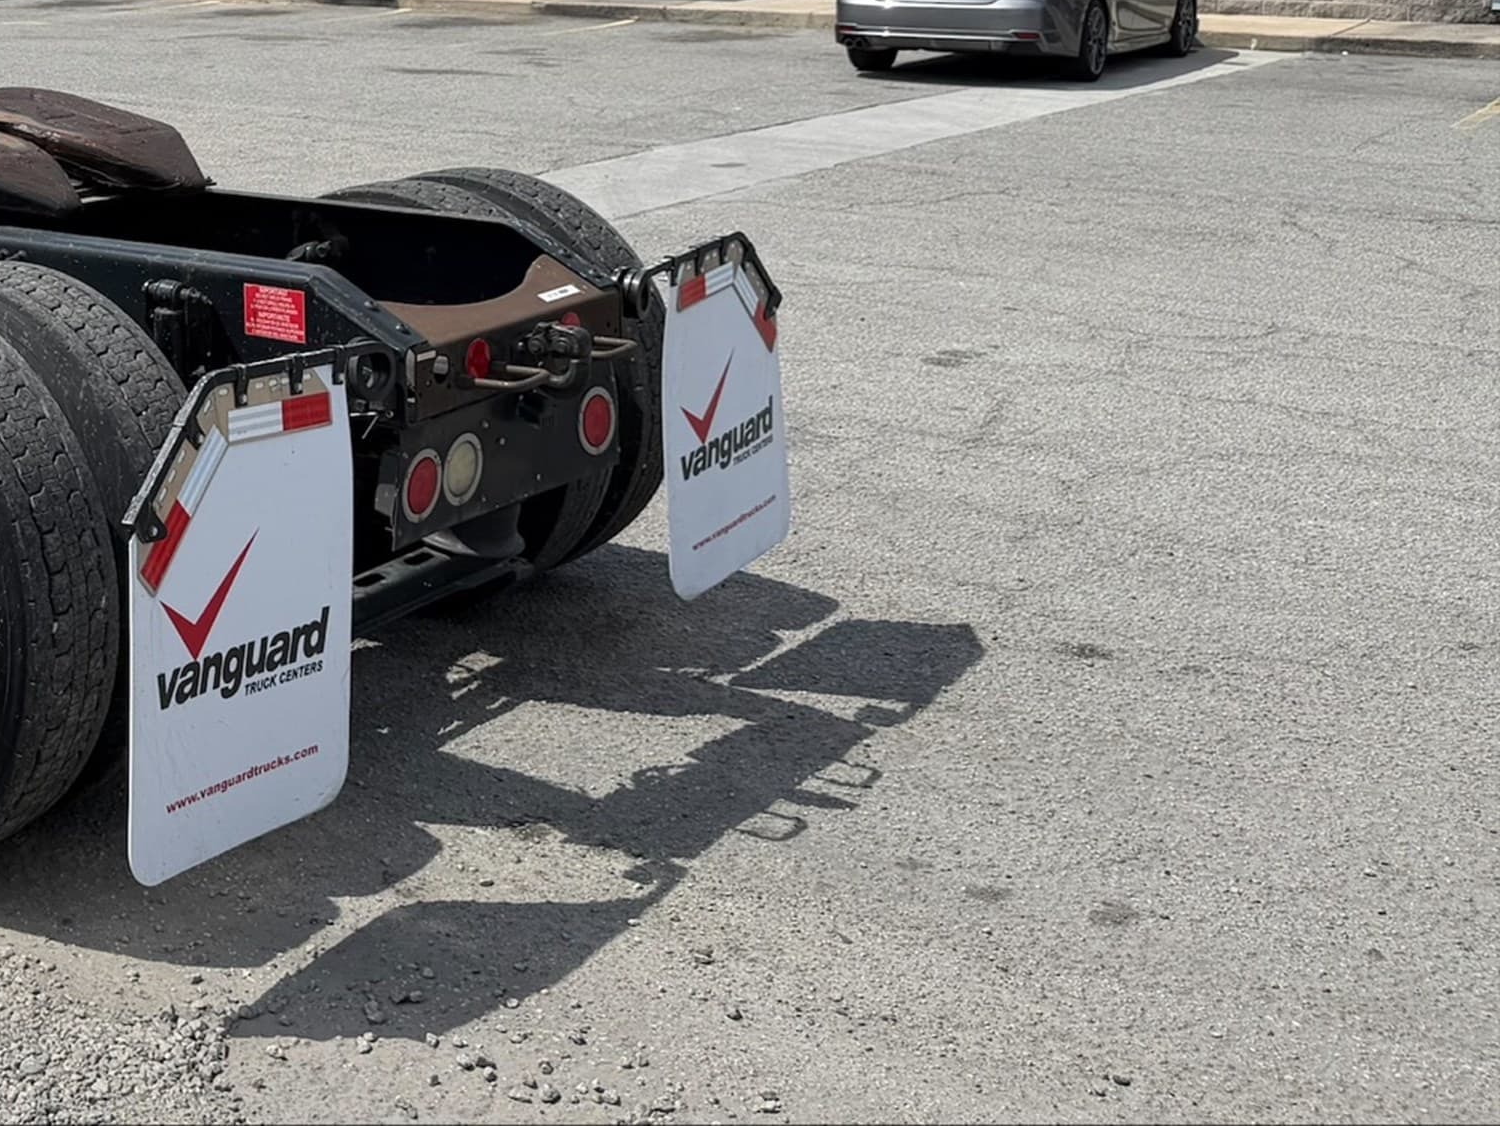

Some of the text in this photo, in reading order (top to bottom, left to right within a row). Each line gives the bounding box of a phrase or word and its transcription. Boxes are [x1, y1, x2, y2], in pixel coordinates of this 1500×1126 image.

[680, 394, 773, 482] vanguard
[156, 605, 331, 710] vanguard
[244, 659, 324, 696] TRUCK CENTERS
[165, 743, 319, 815] www.vanguardtrucks.com
